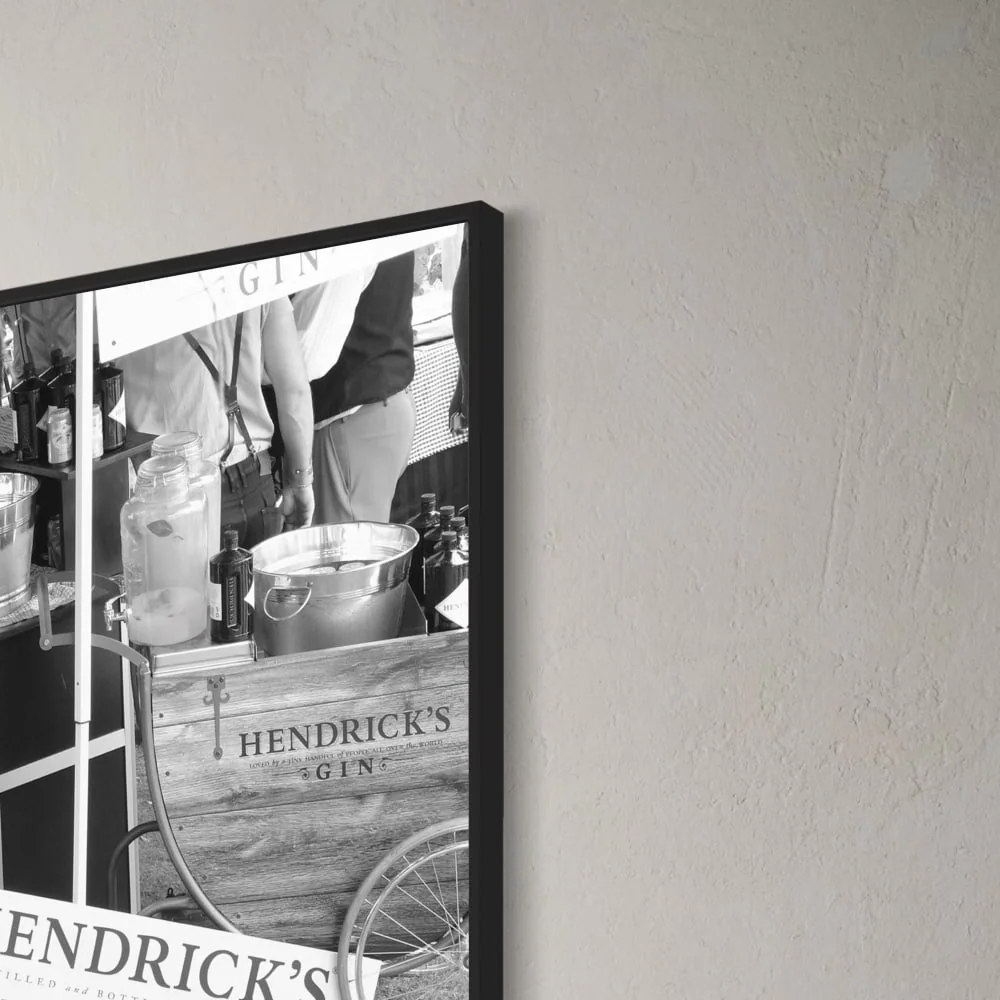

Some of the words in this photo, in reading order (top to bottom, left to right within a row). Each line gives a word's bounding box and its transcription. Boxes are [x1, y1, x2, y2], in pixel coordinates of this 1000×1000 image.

[239, 250, 319, 296] GIN
[239, 706, 450, 757] HENDRICK'S
[316, 757, 374, 780] GIN
[65, 984, 89, 995] and
